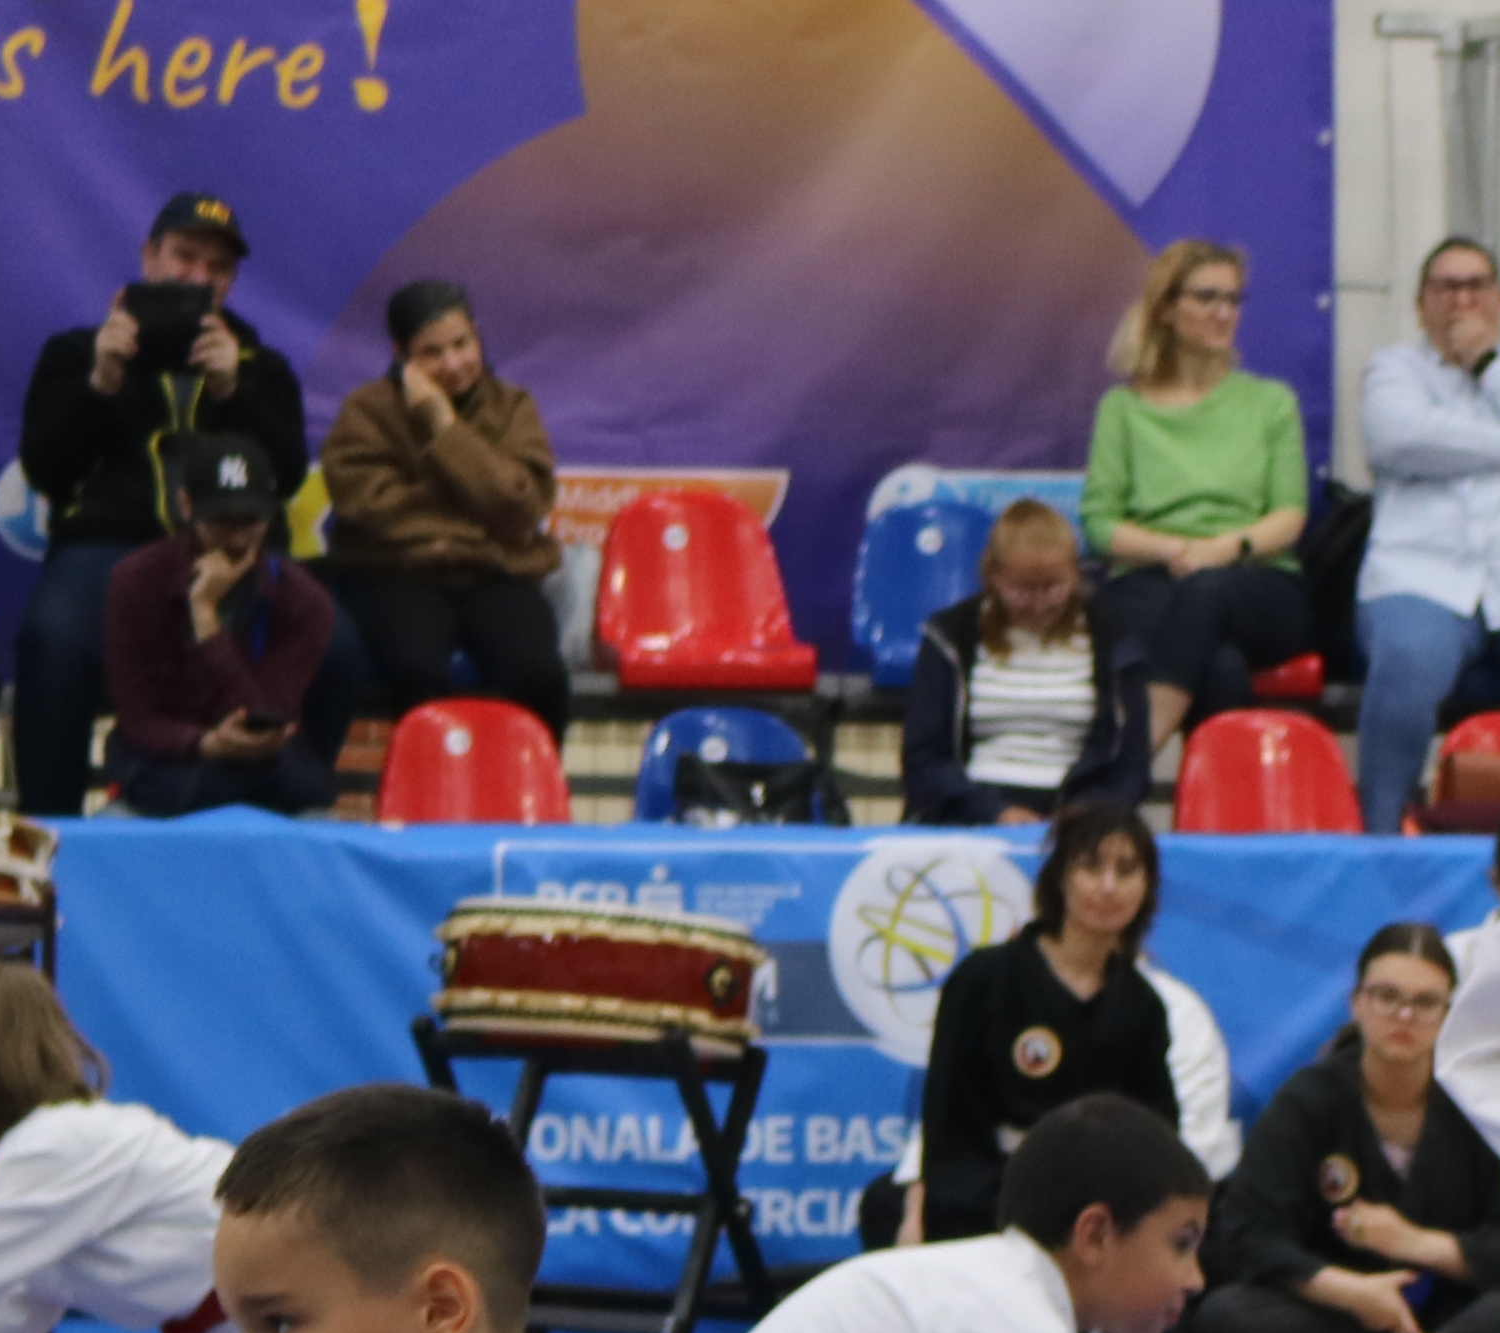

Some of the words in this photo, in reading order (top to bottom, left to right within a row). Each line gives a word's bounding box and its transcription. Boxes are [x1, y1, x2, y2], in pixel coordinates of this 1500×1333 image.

[90, 0, 388, 111] here!
[529, 1113, 701, 1163] ONALA
[806, 1113, 908, 1163] BAS
